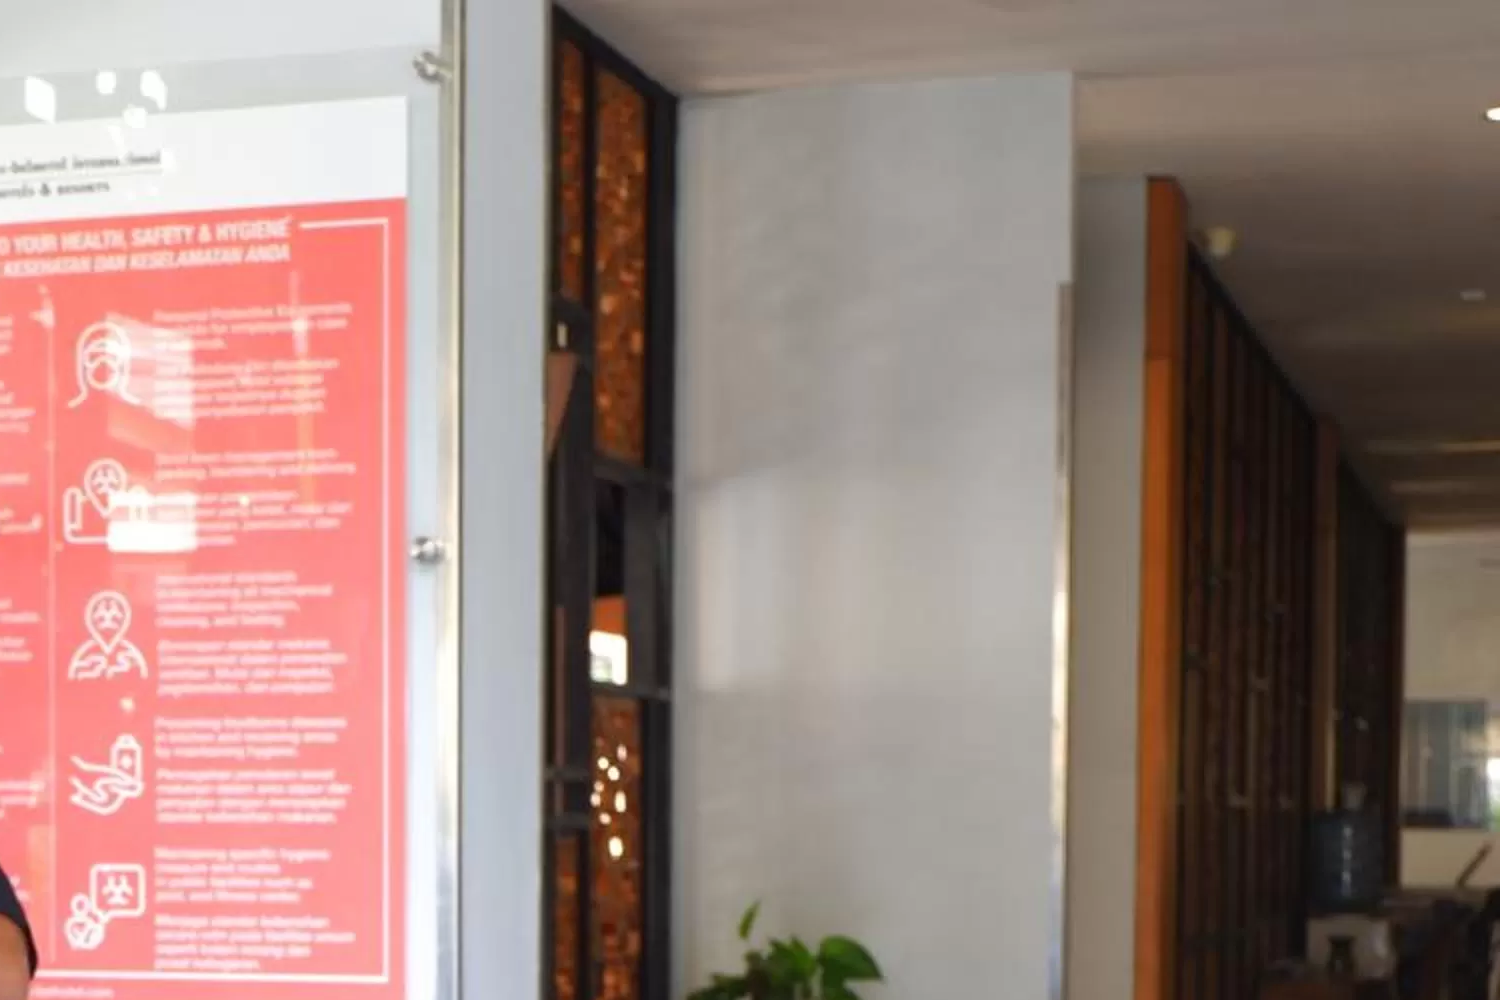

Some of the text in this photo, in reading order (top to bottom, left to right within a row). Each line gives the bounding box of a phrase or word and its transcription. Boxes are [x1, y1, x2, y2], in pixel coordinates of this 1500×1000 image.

[13, 231, 58, 254] YOUR
[60, 227, 127, 252] HEALTH,
[130, 224, 195, 247] SAFETY
[198, 223, 212, 243] &
[215, 218, 291, 242] HYGIENE
